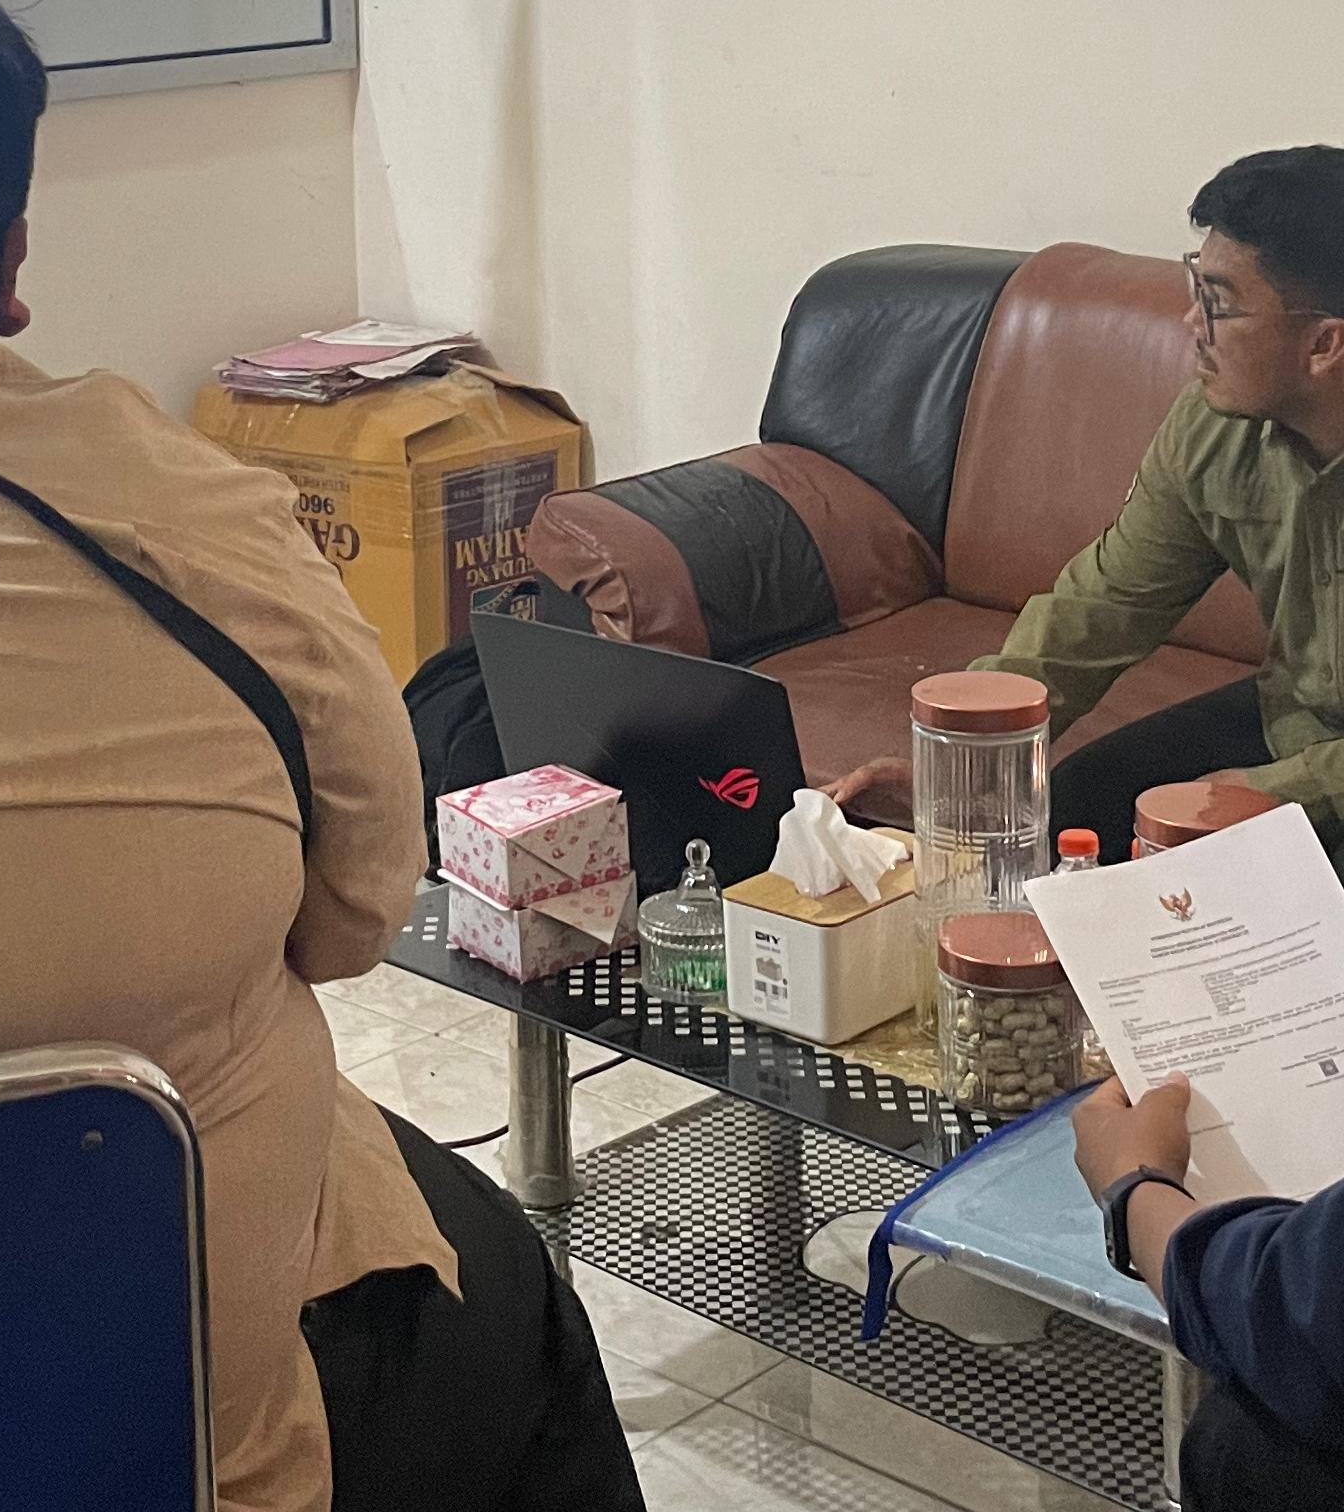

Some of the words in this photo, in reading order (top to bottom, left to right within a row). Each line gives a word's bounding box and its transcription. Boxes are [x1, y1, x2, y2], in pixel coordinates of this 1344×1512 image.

[299, 492, 336, 516] 960
[294, 517, 361, 562] GA
[755, 930, 781, 945] DIY
